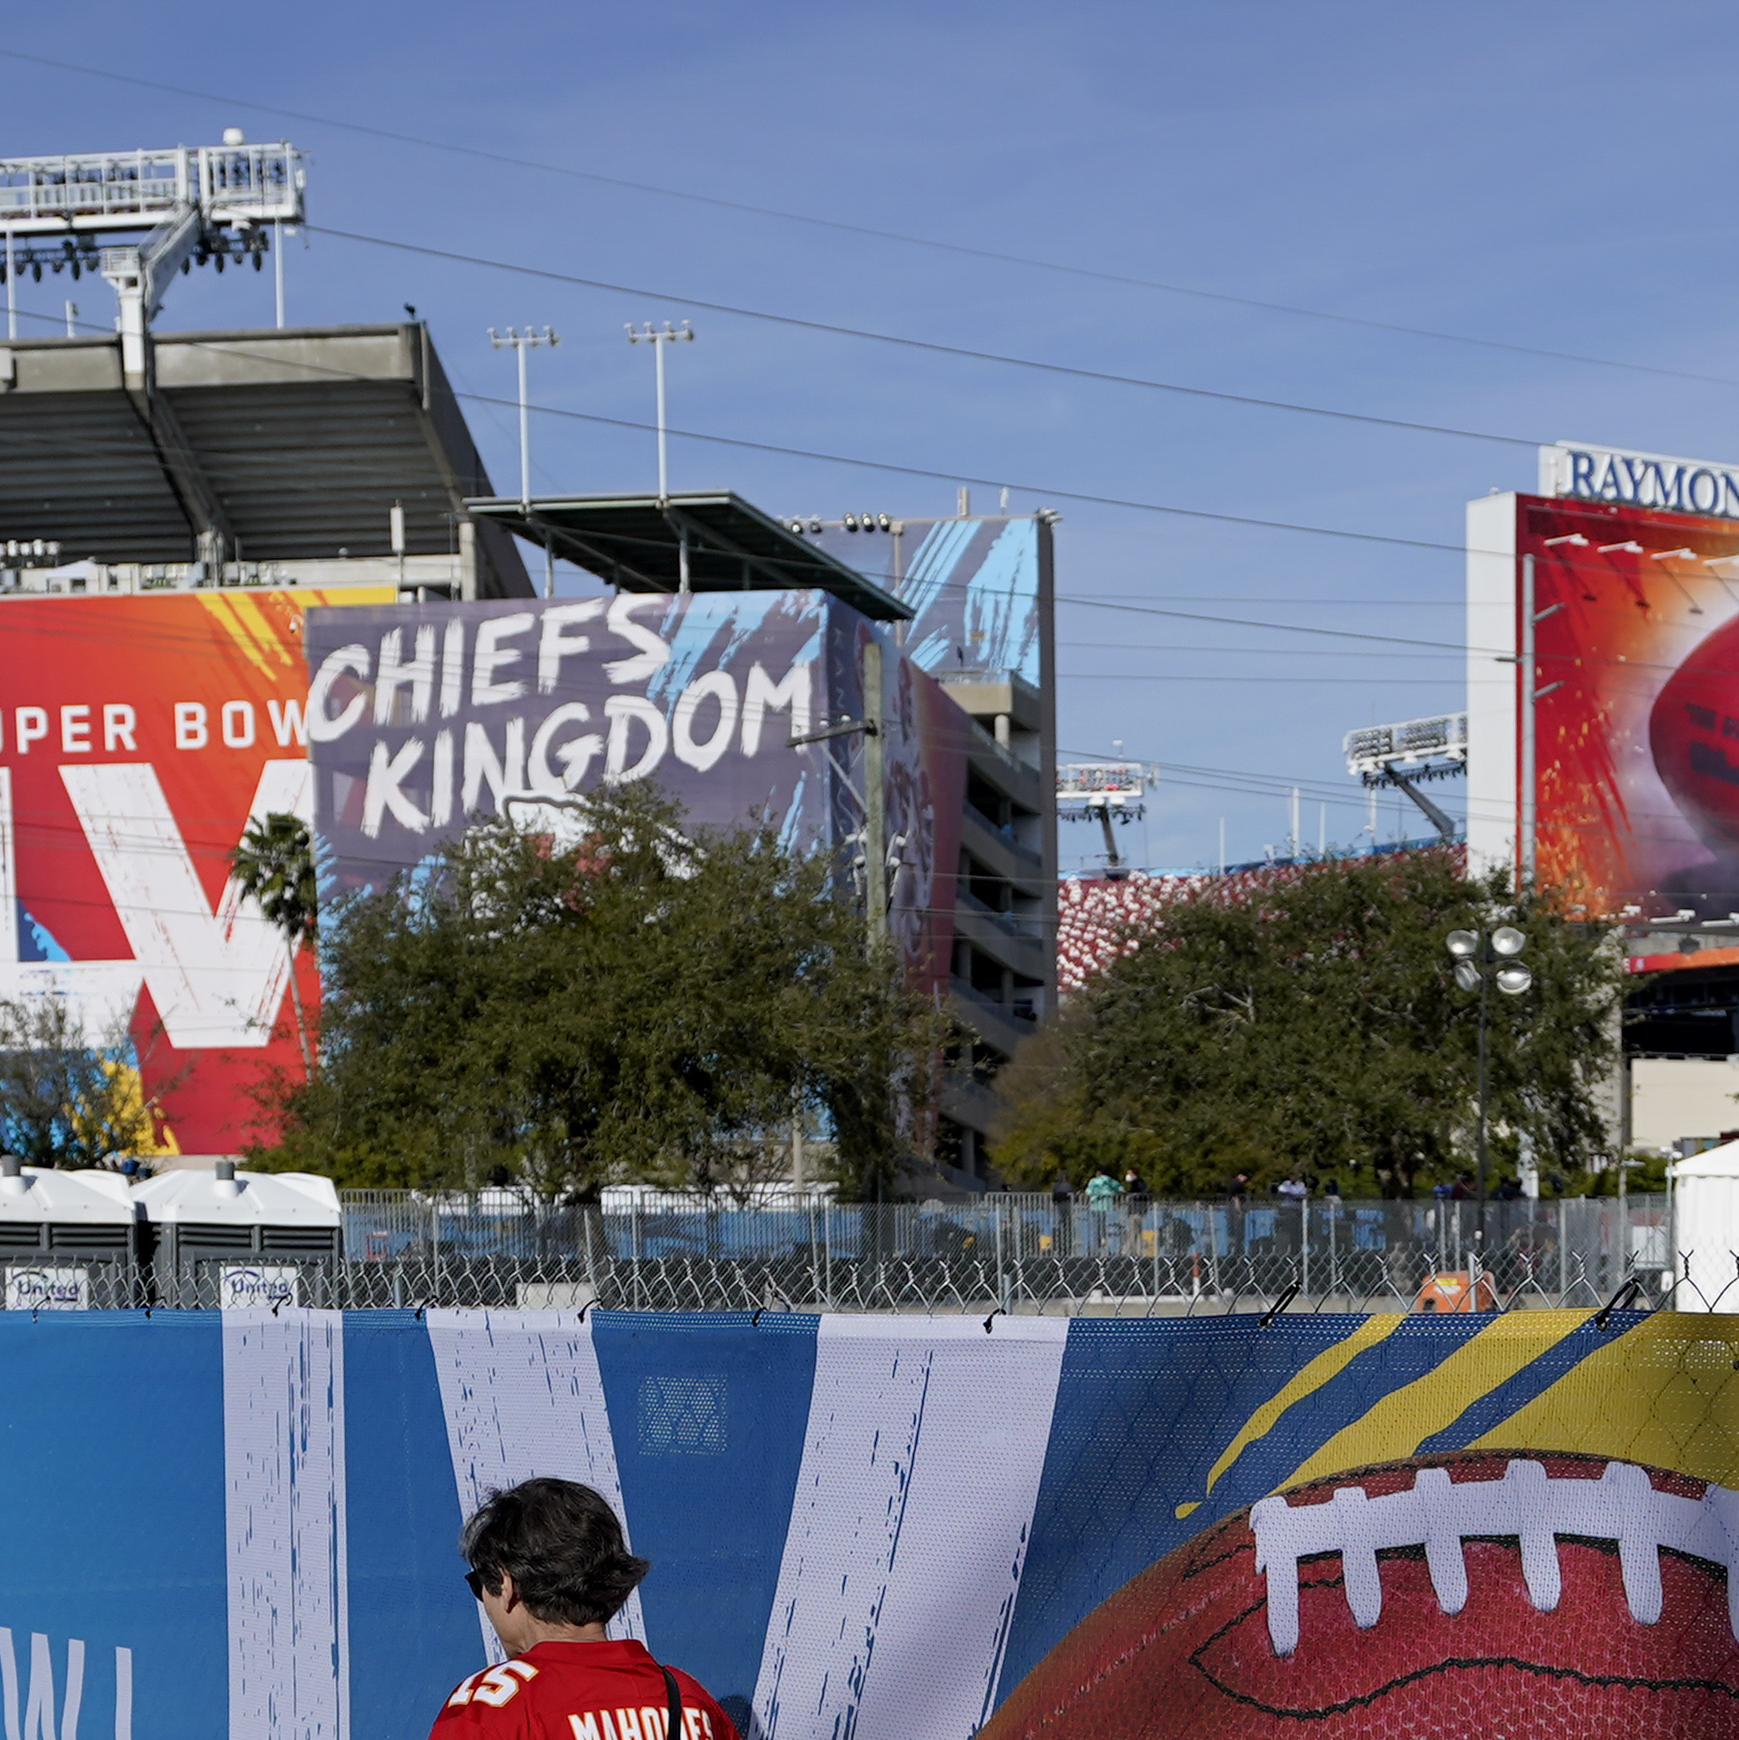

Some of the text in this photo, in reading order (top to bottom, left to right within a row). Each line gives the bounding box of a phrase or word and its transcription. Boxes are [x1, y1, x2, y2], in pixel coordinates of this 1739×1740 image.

[307, 594, 671, 743] CHIEFS
[173, 699, 310, 749] BOW
[361, 660, 814, 840] KINGDOM
[446, 1659, 540, 1708] 15
